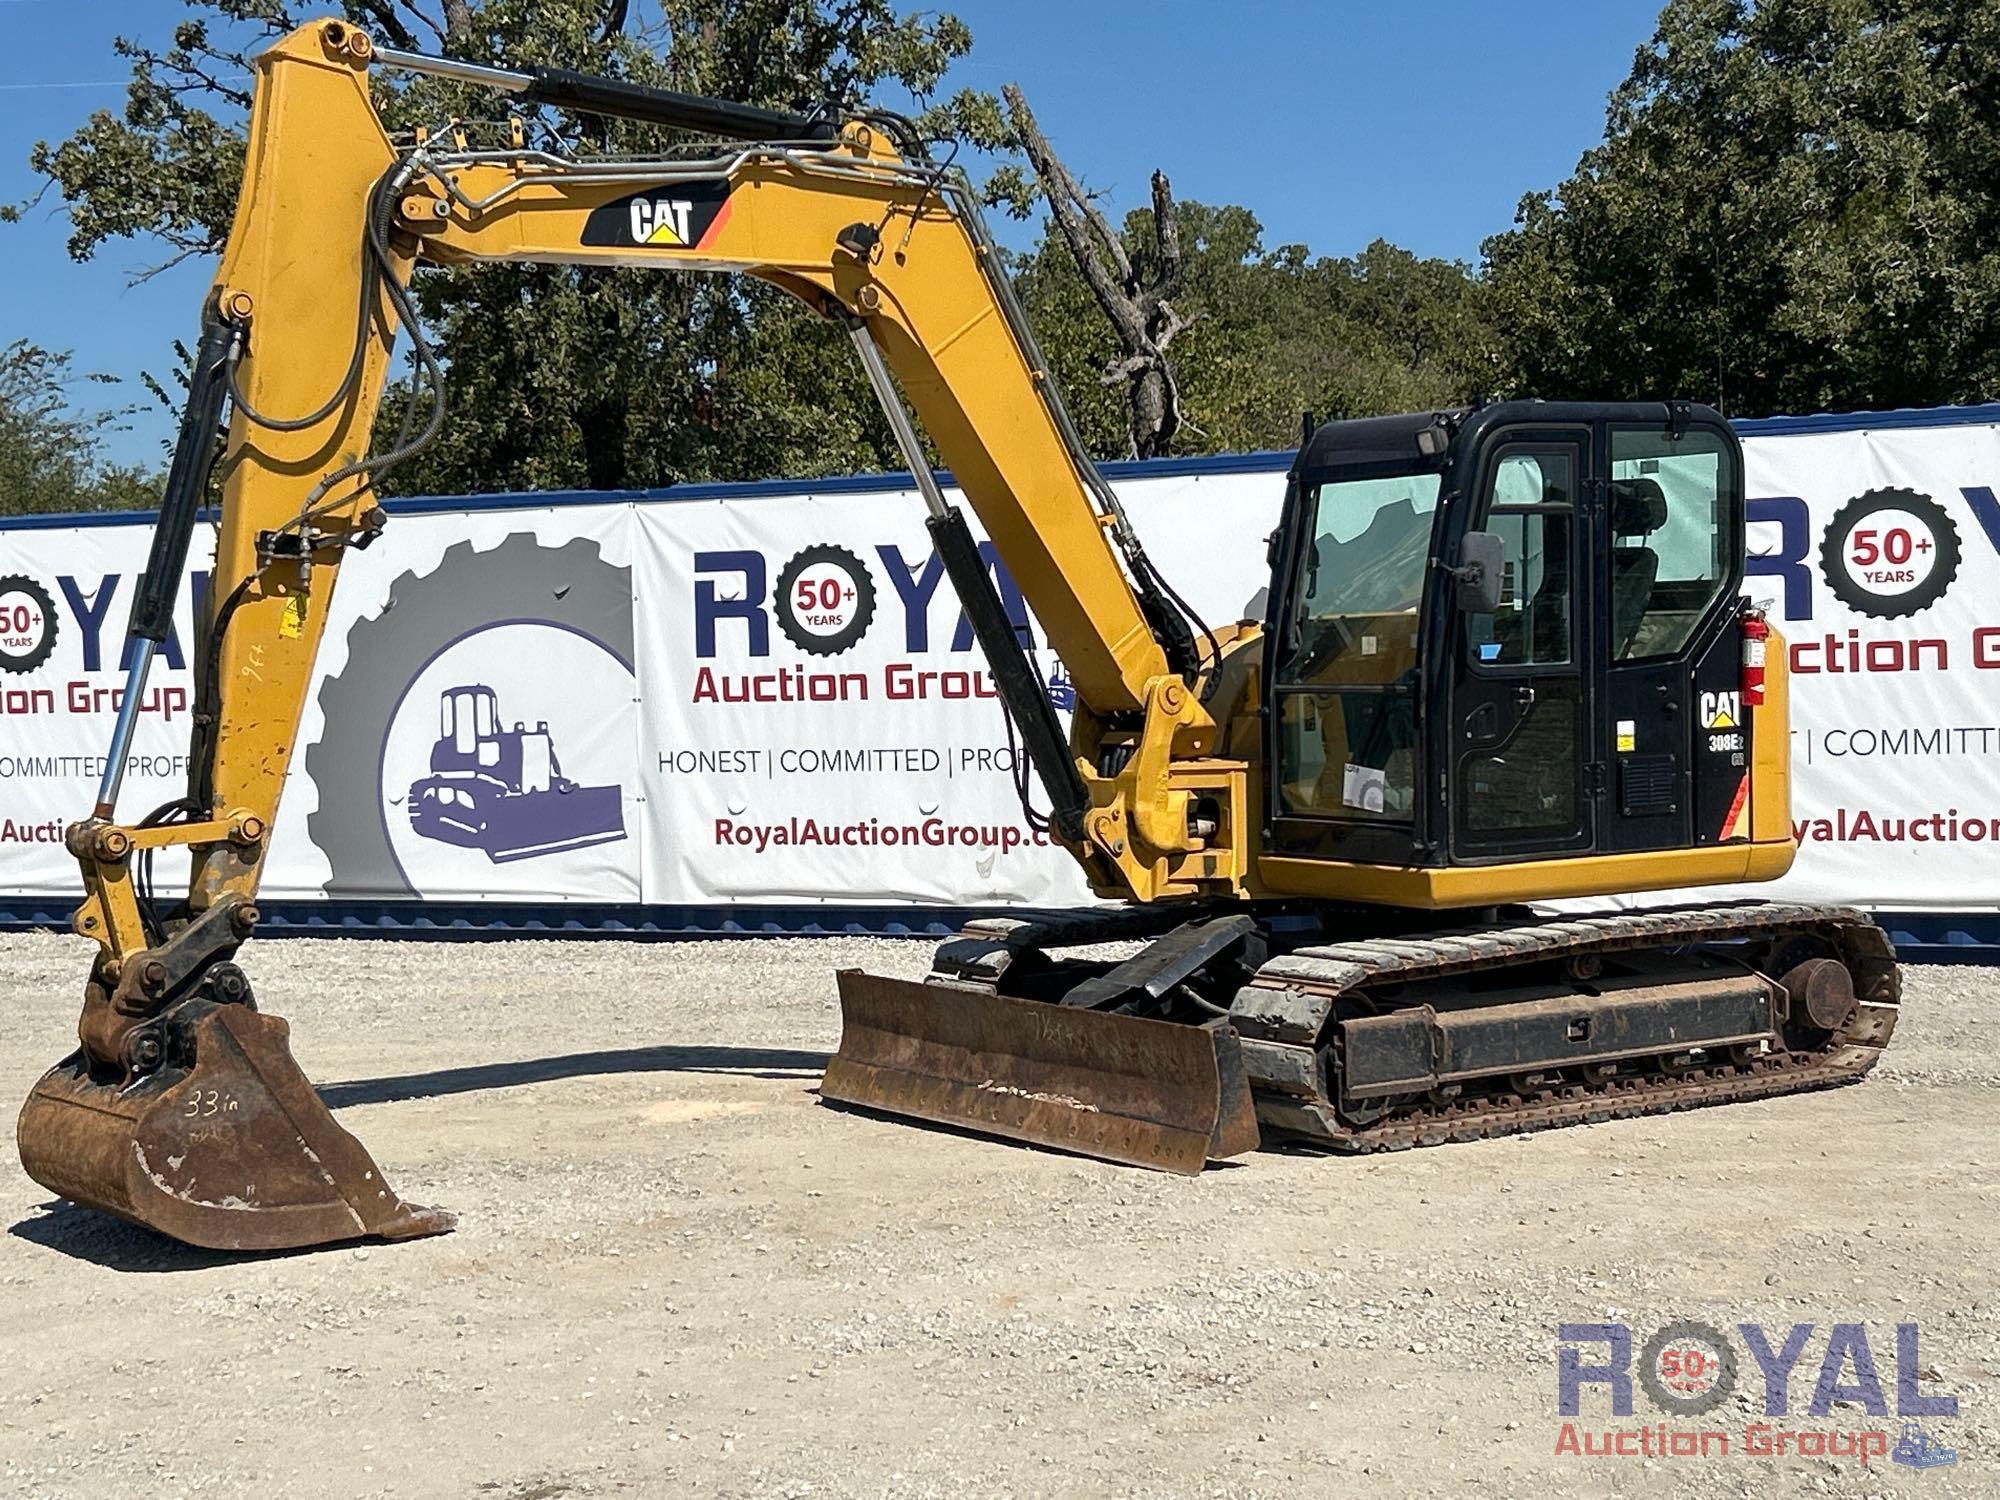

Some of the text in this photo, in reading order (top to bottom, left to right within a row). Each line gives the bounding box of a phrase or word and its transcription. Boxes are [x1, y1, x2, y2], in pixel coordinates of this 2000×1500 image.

[630, 197, 692, 244] CAT
[1851, 528, 1932, 566] 50+
[1864, 570, 1915, 583] YEARS
[796, 579, 855, 610] 50+
[0, 605, 41, 633] 50+
[806, 615, 843, 626] YEARS
[3, 637, 33, 647] YEARS
[693, 663, 998, 703] Auction Grou
[1701, 691, 1741, 729] CAT
[1824, 728, 2000, 756] COMMITT
[658, 750, 761, 773] HONEST
[780, 748, 940, 772] COMMITTED
[715, 817, 1064, 853] RoyalAuctionGroup.c
